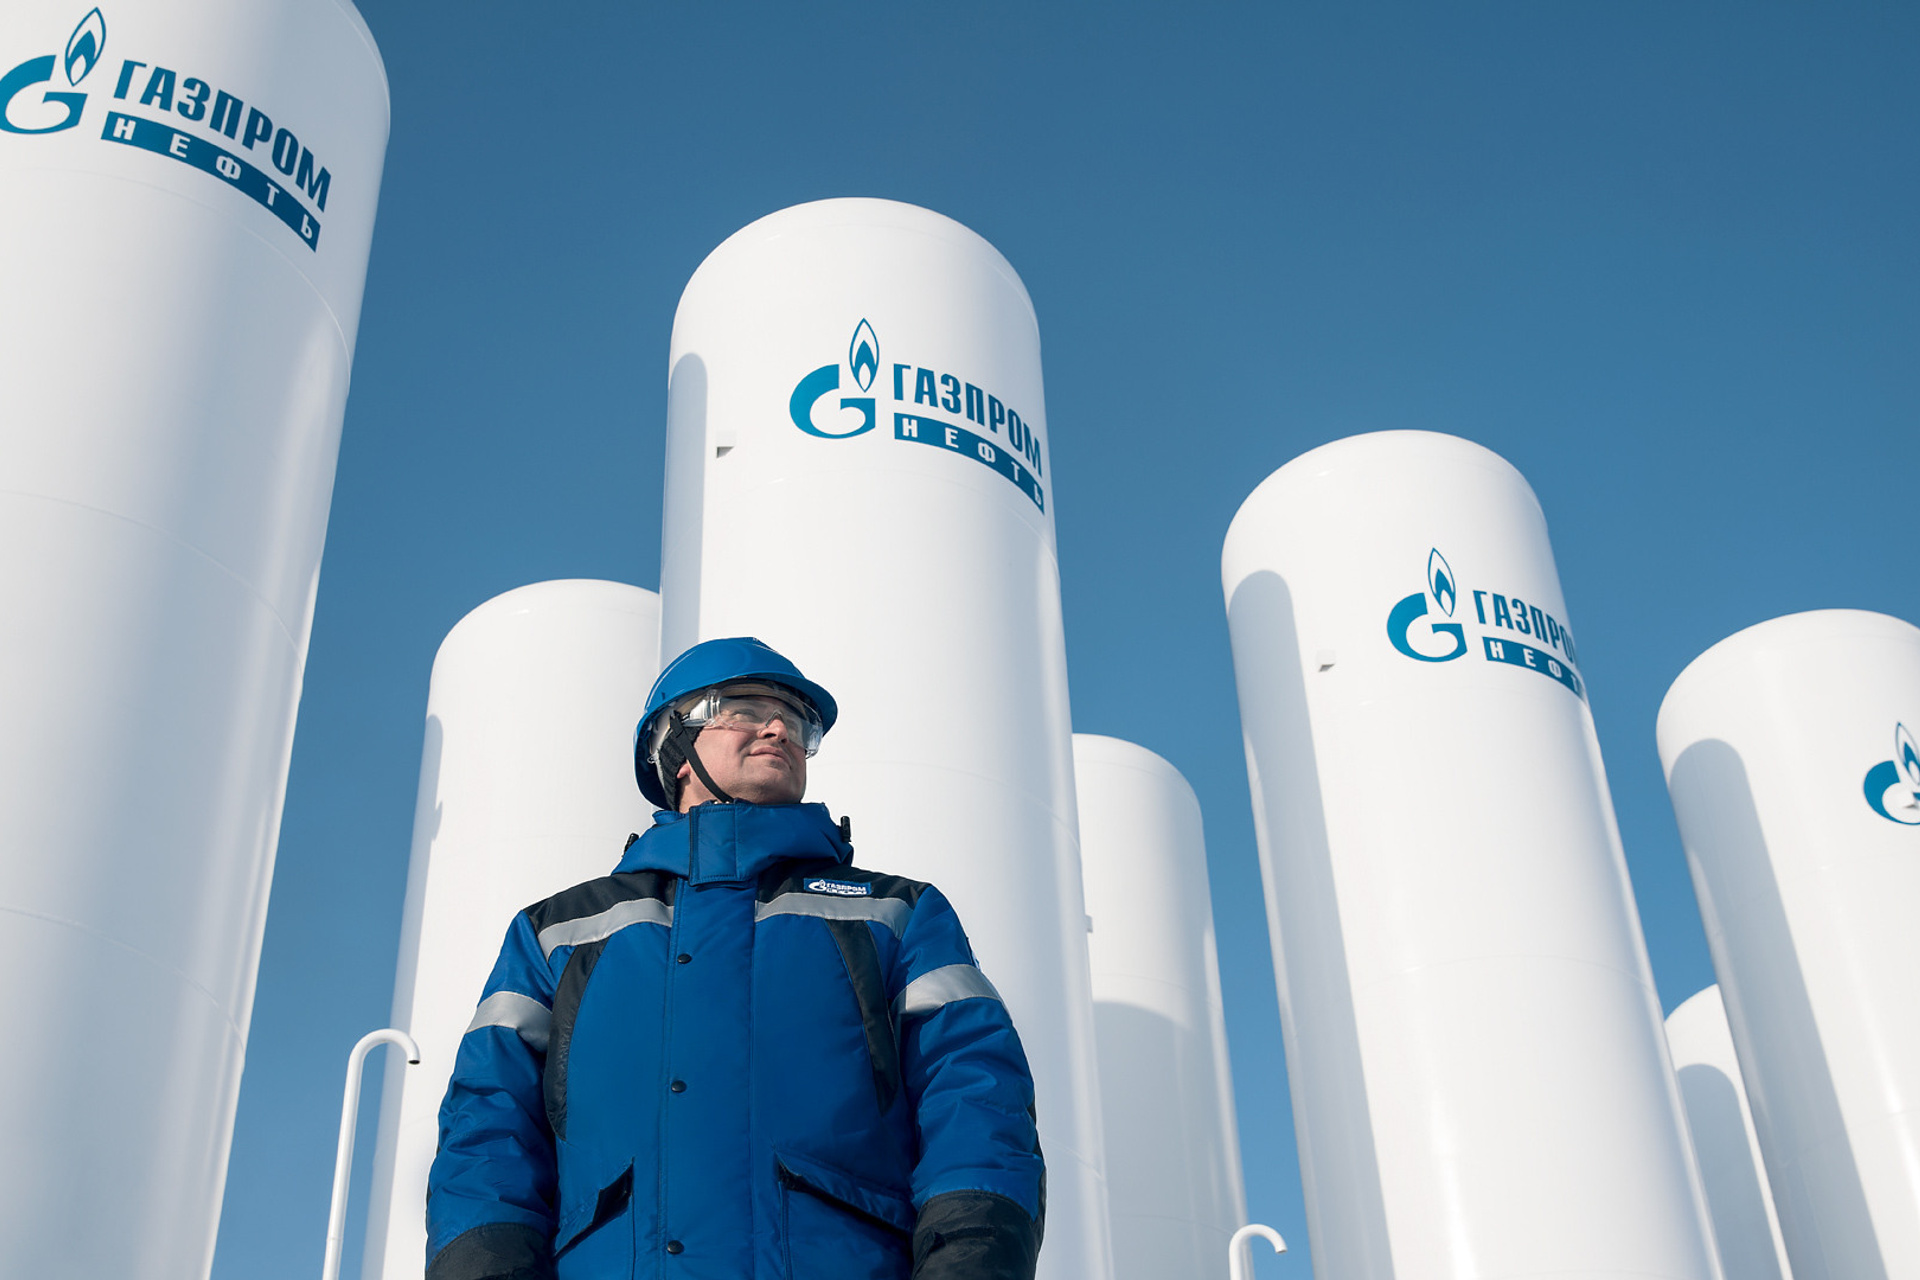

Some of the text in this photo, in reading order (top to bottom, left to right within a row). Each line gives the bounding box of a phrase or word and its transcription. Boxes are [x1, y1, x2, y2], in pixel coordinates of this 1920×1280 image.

[112, 116, 313, 241] НЕФТЬ
[113, 59, 332, 213] ГАЗПРОМ
[893, 362, 1043, 479] ГАЗПРОМ
[902, 417, 1043, 507] НЕФТЬ
[1472, 589, 1578, 665] ГАЗПРО
